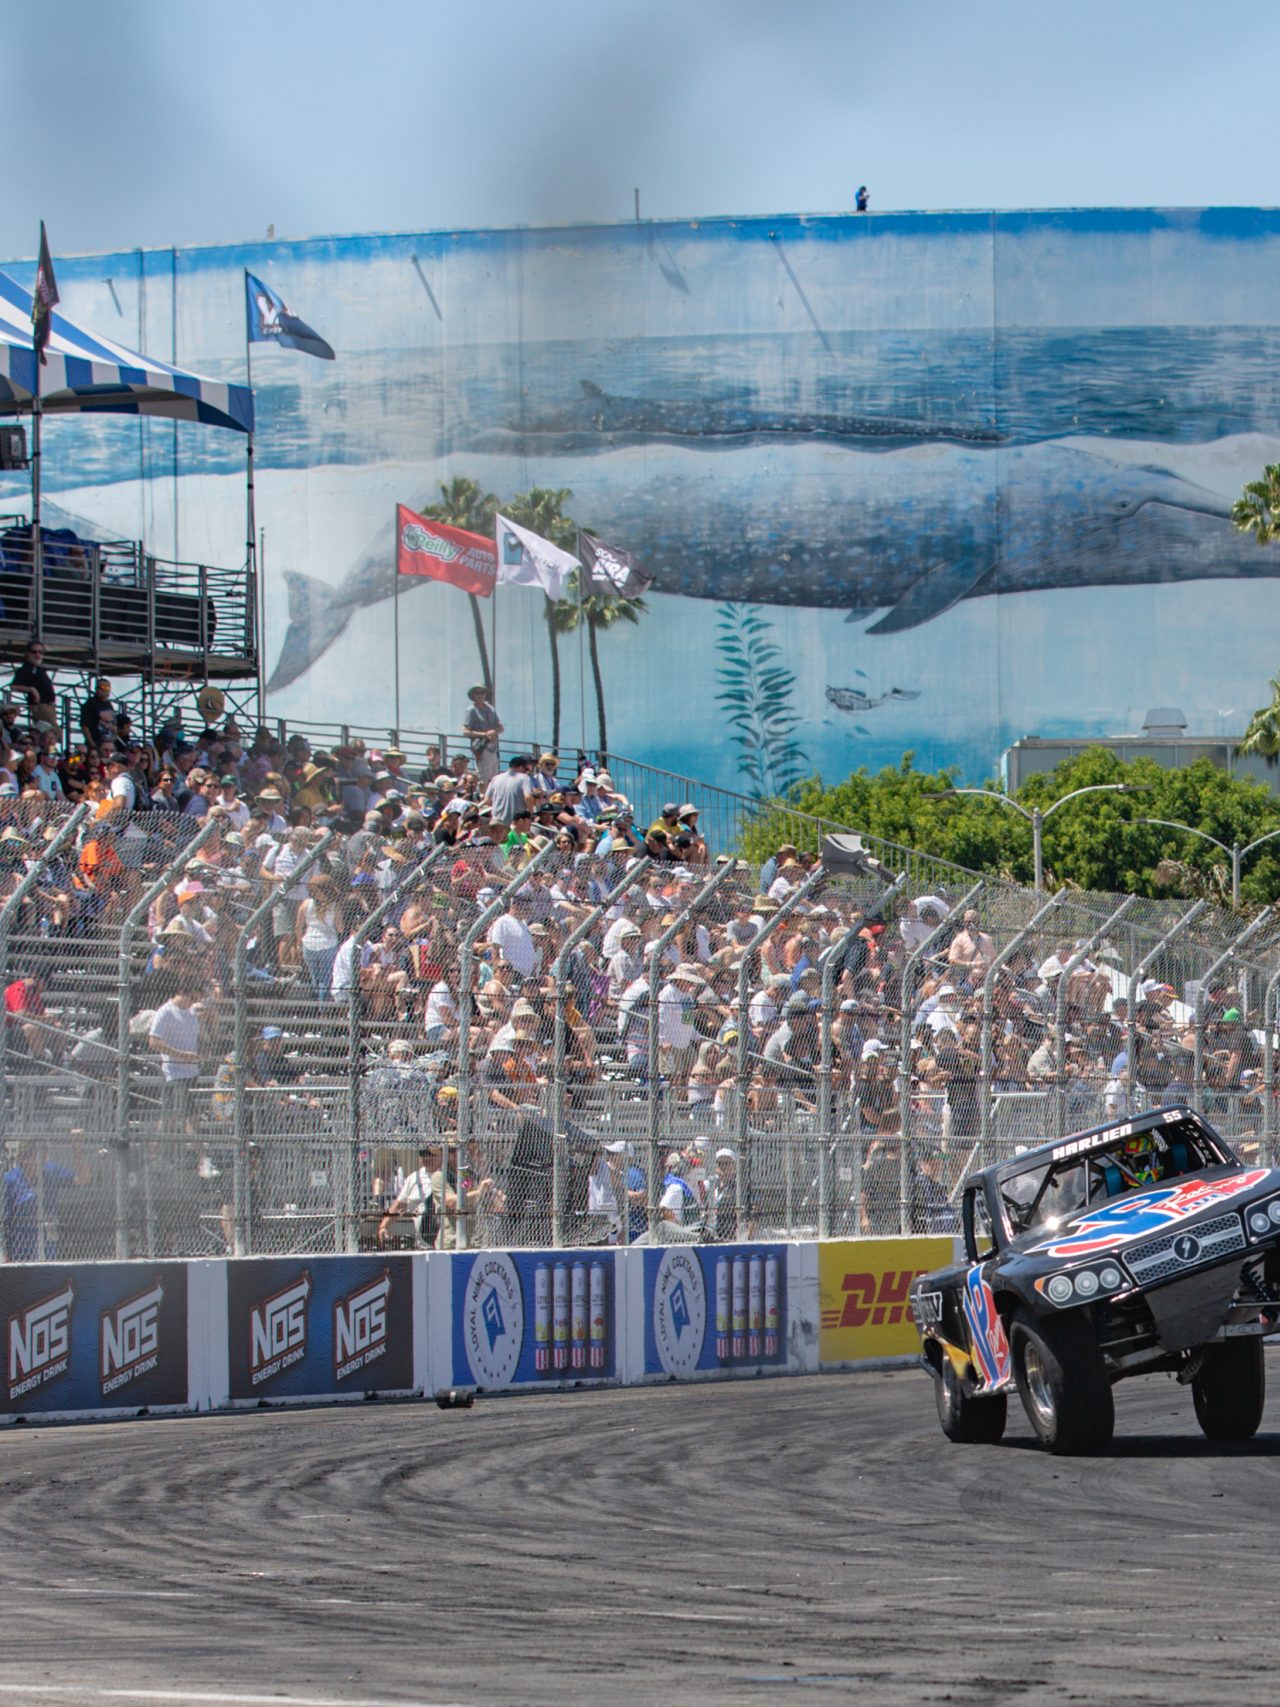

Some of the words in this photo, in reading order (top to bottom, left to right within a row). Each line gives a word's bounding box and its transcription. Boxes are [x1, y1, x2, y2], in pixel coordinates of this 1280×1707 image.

[459, 555, 496, 576] PARTS
[467, 546, 495, 562] AUTO
[1162, 1109, 1183, 1124] 55
[1052, 1123, 1133, 1161] HARLIEN
[472, 1271, 485, 1302] NINE
[484, 1261, 514, 1300] COCKTAILS
[10, 1284, 74, 1382] NOS
[103, 1282, 164, 1377] NOS
[252, 1276, 311, 1369] NOS
[336, 1274, 391, 1365] NOS
[470, 1309, 479, 1353] LOYAL
[659, 1302, 668, 1342] LOYAL
[10, 1374, 42, 1400] ENERGY
[43, 1358, 68, 1382] DRINK
[103, 1369, 134, 1395] ENERGY
[134, 1354, 158, 1377] DRINK
[252, 1359, 281, 1386] ENERGY
[282, 1346, 305, 1367] DRINK
[336, 1356, 364, 1381] ENERGY
[364, 1342, 387, 1363] DRINK
